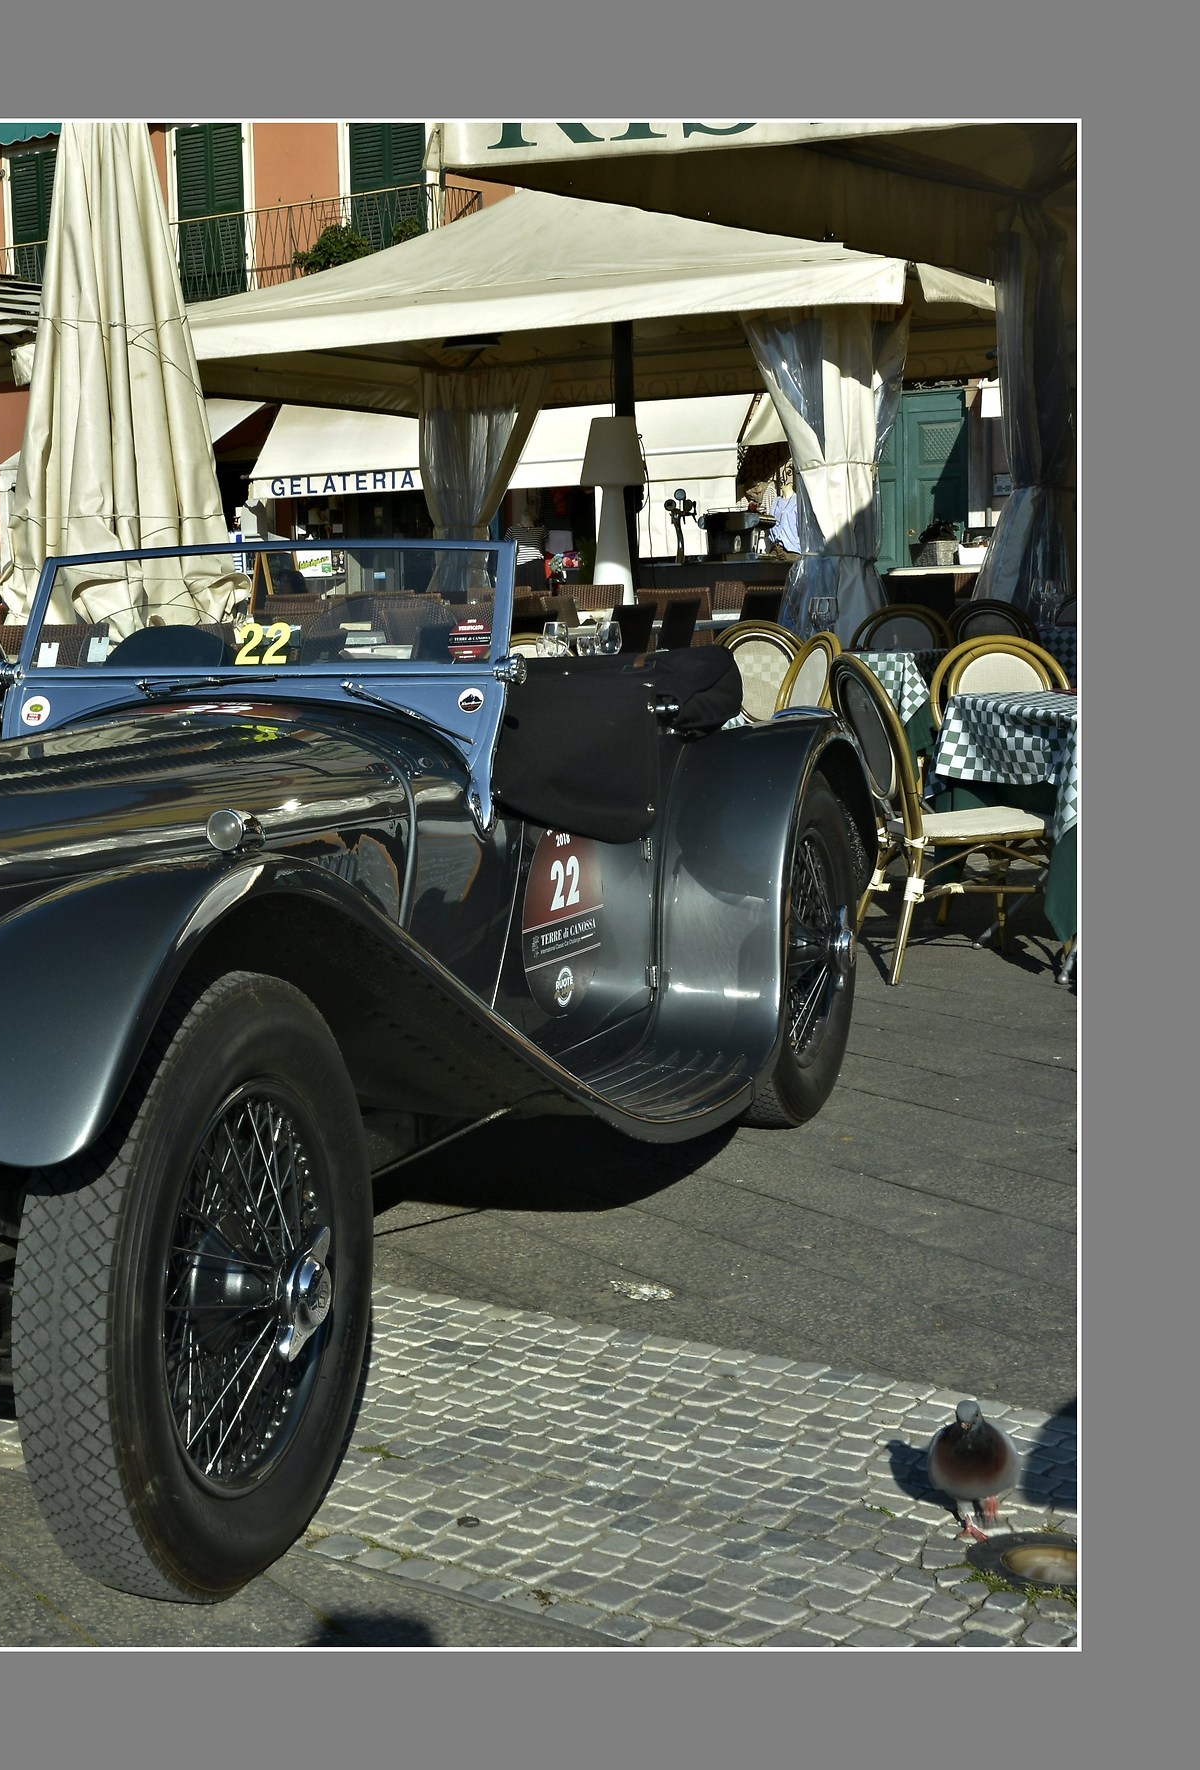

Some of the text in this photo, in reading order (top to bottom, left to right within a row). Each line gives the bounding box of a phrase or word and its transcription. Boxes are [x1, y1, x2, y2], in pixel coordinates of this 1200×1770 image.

[271, 470, 415, 497] GELATERIA
[235, 621, 291, 665] 22
[555, 833, 571, 848] 2018
[550, 855, 580, 912] 22
[540, 929, 563, 946] TERRE
[569, 917, 596, 936] CANOSSA
